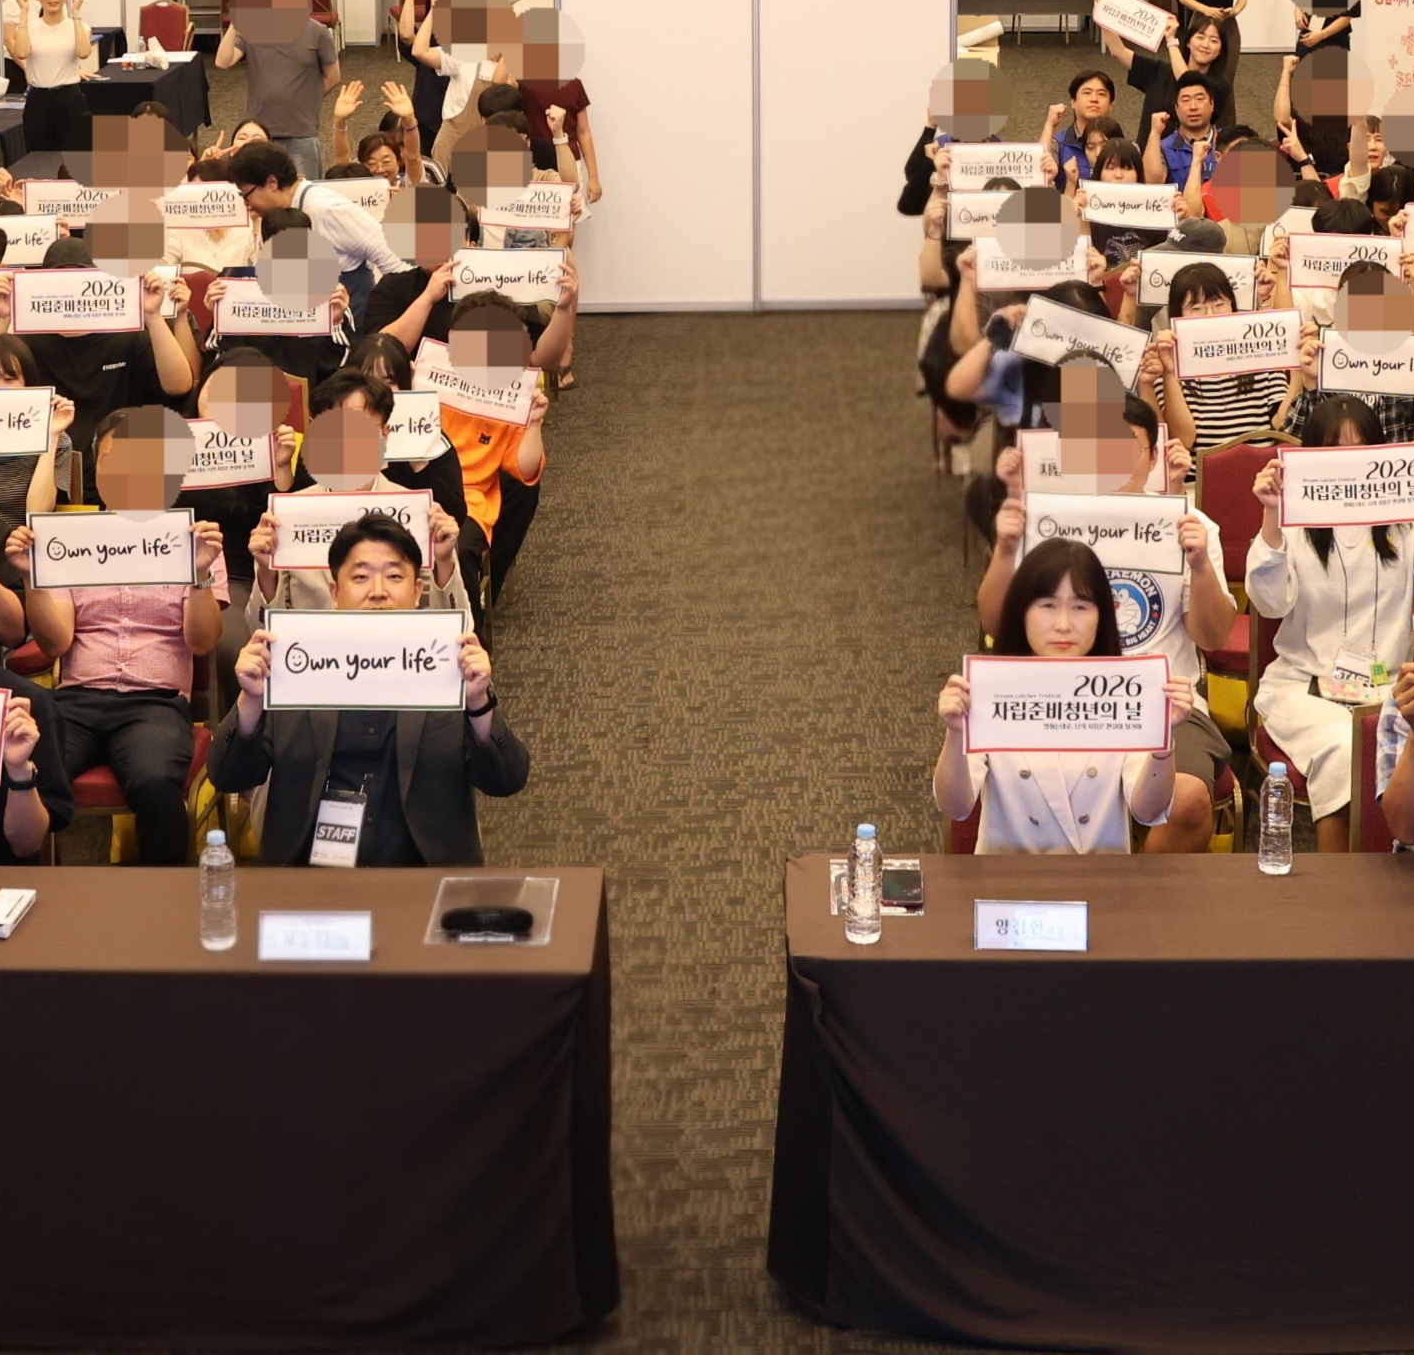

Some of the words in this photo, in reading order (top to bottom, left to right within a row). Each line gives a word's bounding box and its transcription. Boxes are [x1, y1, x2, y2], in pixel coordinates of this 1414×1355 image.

[998, 151, 1033, 164] 2026
[960, 164, 1022, 176] 자립준비청년의
[1024, 164, 1033, 175] 날
[1242, 321, 1287, 340] 2026
[1193, 340, 1272, 360] 자립준비청년의
[1276, 338, 1287, 351] 날
[1302, 480, 1401, 502] 자립준비청년의
[46, 536, 92, 562] Own
[96, 544, 138, 565] your
[142, 537, 171, 557] life
[1125, 636, 1138, 646] BIG
[1138, 620, 1157, 641] HEART
[284, 641, 340, 674] Own
[345, 654, 396, 681] your
[402, 647, 437, 674] life
[1073, 675, 1143, 697] 2026
[992, 701, 1118, 721] 자립준비청년의
[1125, 701, 1142, 721] 날
[317, 825, 357, 842] STAFF
